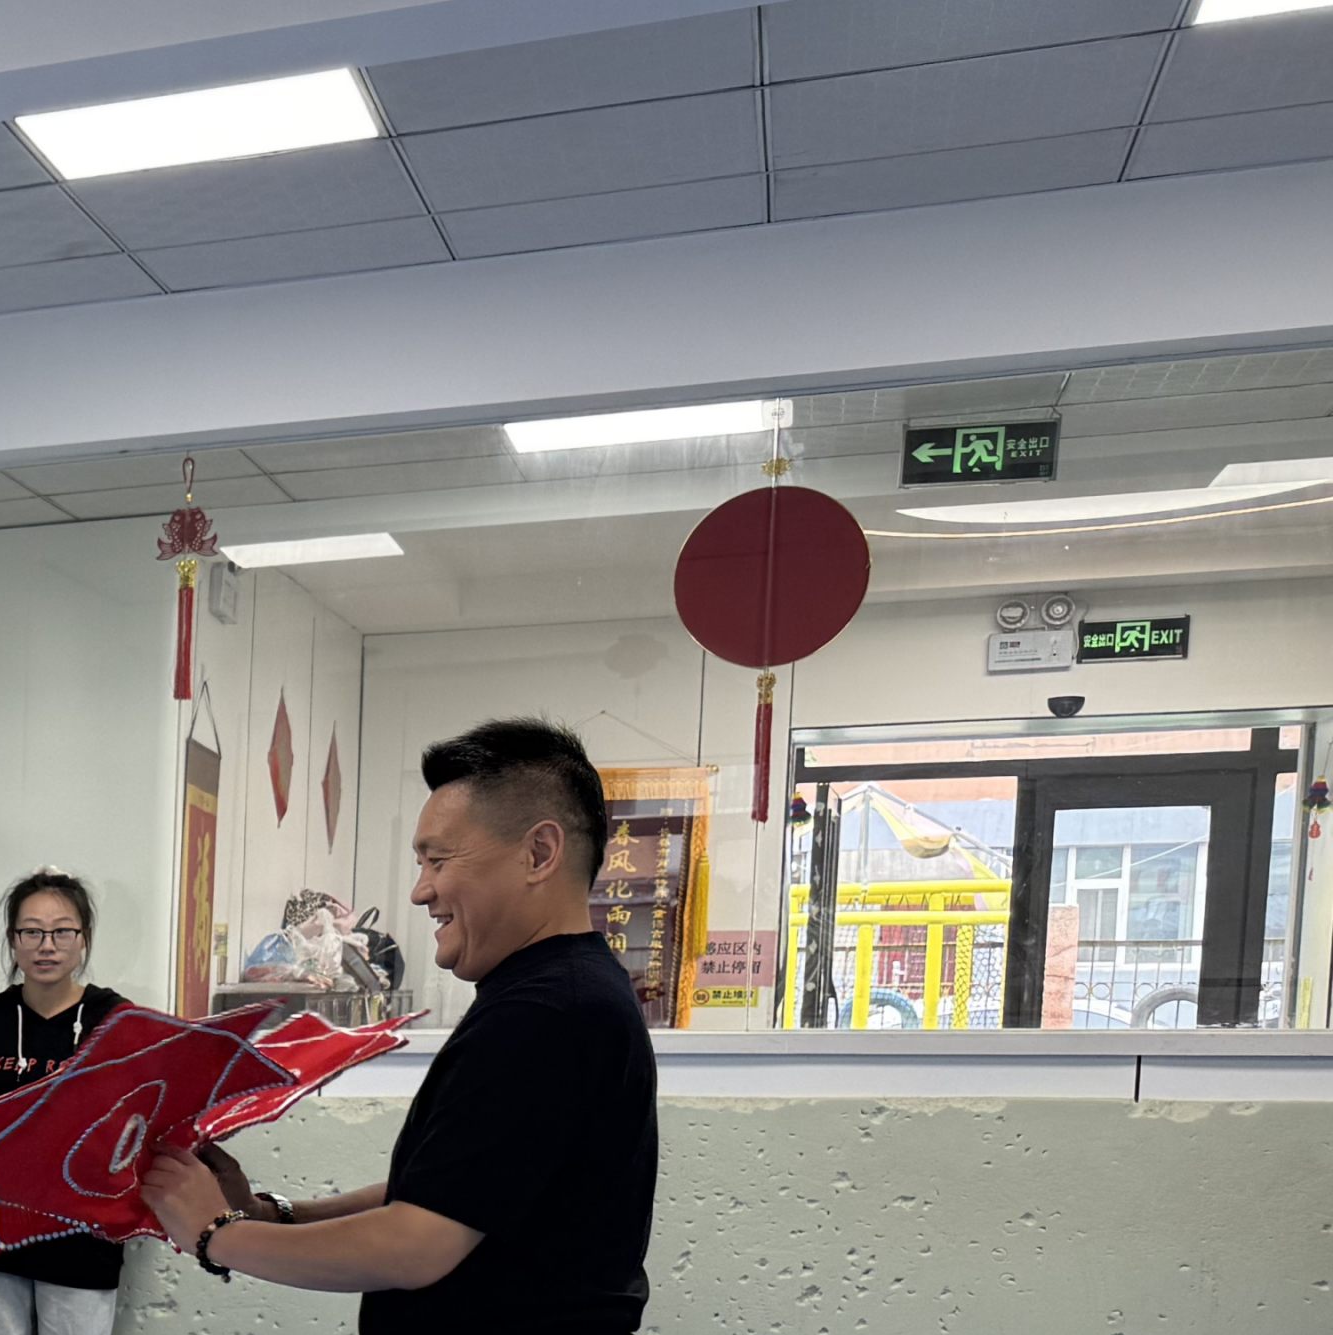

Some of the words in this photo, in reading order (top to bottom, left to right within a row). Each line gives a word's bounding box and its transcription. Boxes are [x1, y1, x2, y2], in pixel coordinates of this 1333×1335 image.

[1006, 437, 1050, 450] 安全出口
[1010, 449, 1043, 458] EXIT
[1083, 633, 1114, 648] 安全出口
[1151, 629, 1183, 645] EXIT
